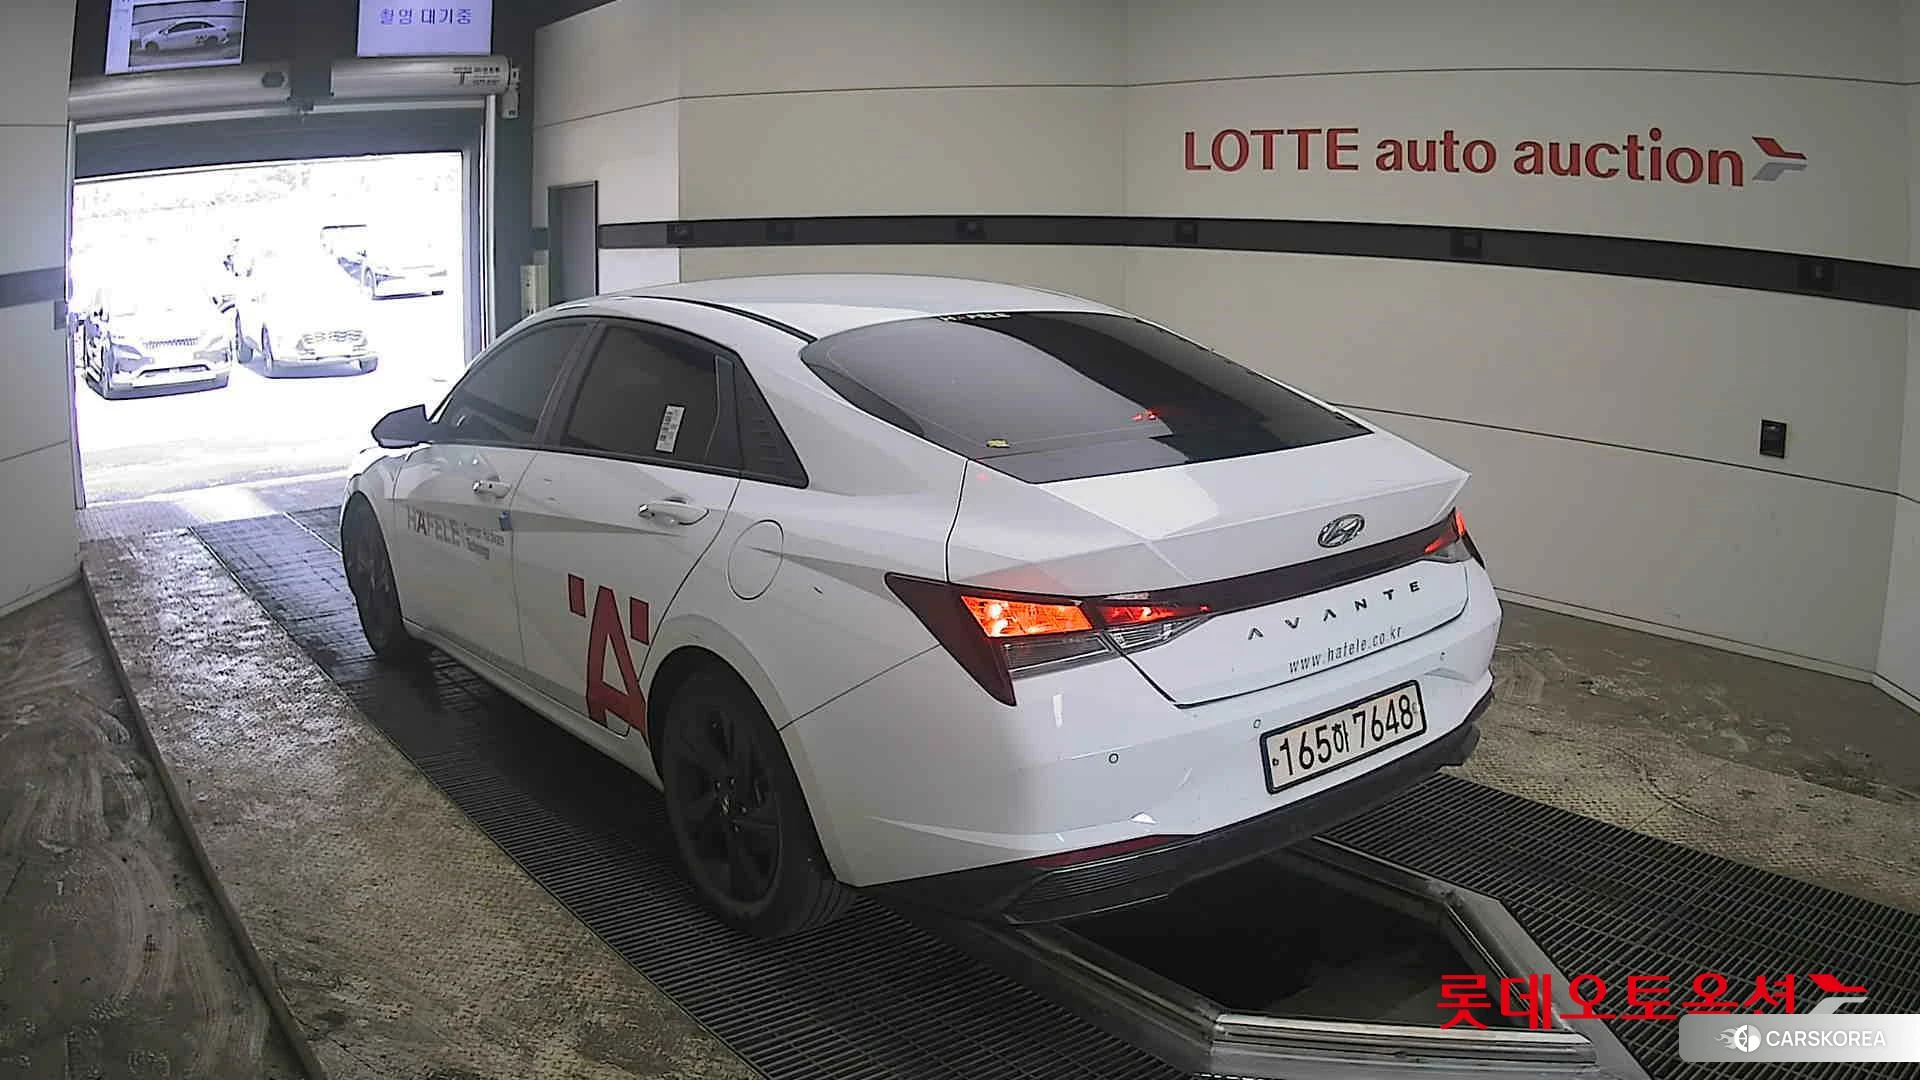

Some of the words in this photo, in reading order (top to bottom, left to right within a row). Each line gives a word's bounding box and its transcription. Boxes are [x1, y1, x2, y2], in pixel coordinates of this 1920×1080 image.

[421, 7, 472, 25] 대기중
[1184, 127, 1359, 172] LOTTE
[1375, 129, 1498, 174] auto
[1512, 127, 1745, 187] auction
[1247, 581, 1422, 642] AVANTE
[1288, 626, 1402, 674] www.hafele.co.kr
[1352, 694, 1414, 748] 7648
